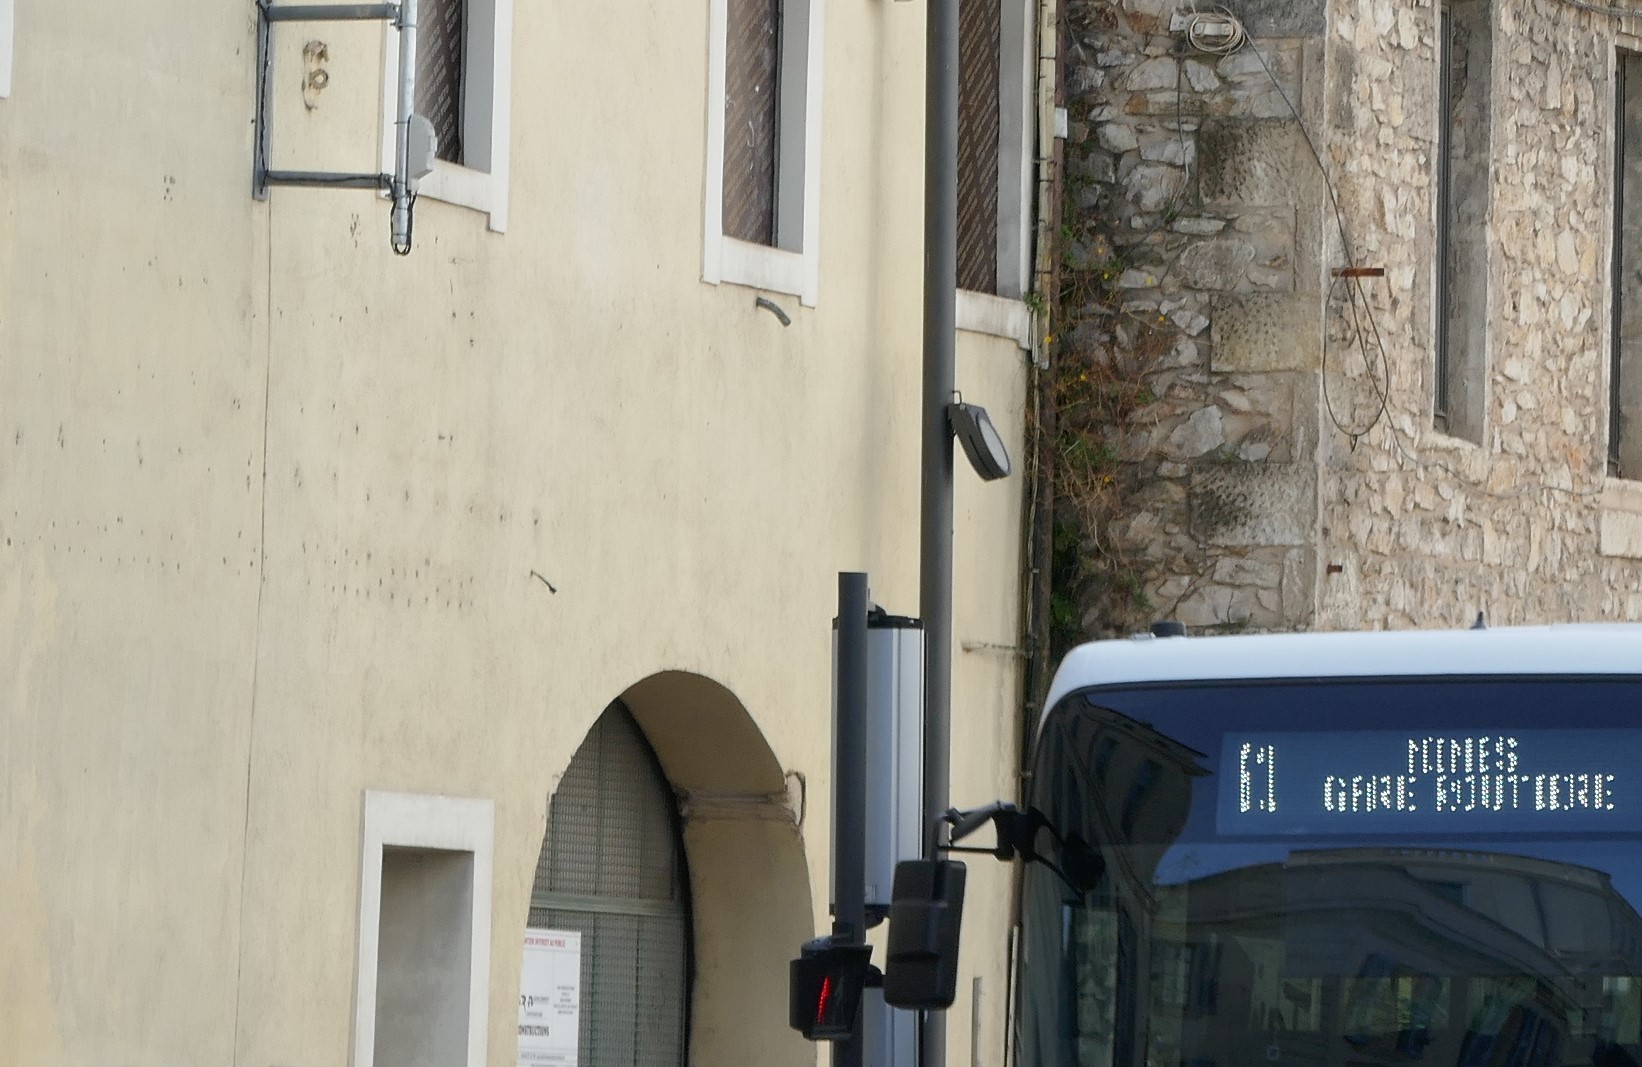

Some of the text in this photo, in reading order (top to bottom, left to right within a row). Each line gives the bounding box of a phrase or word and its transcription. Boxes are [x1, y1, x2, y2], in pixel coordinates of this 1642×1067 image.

[1408, 736, 1518, 773] NIMES
[1324, 774, 1615, 812] GARE ROUTIERE
